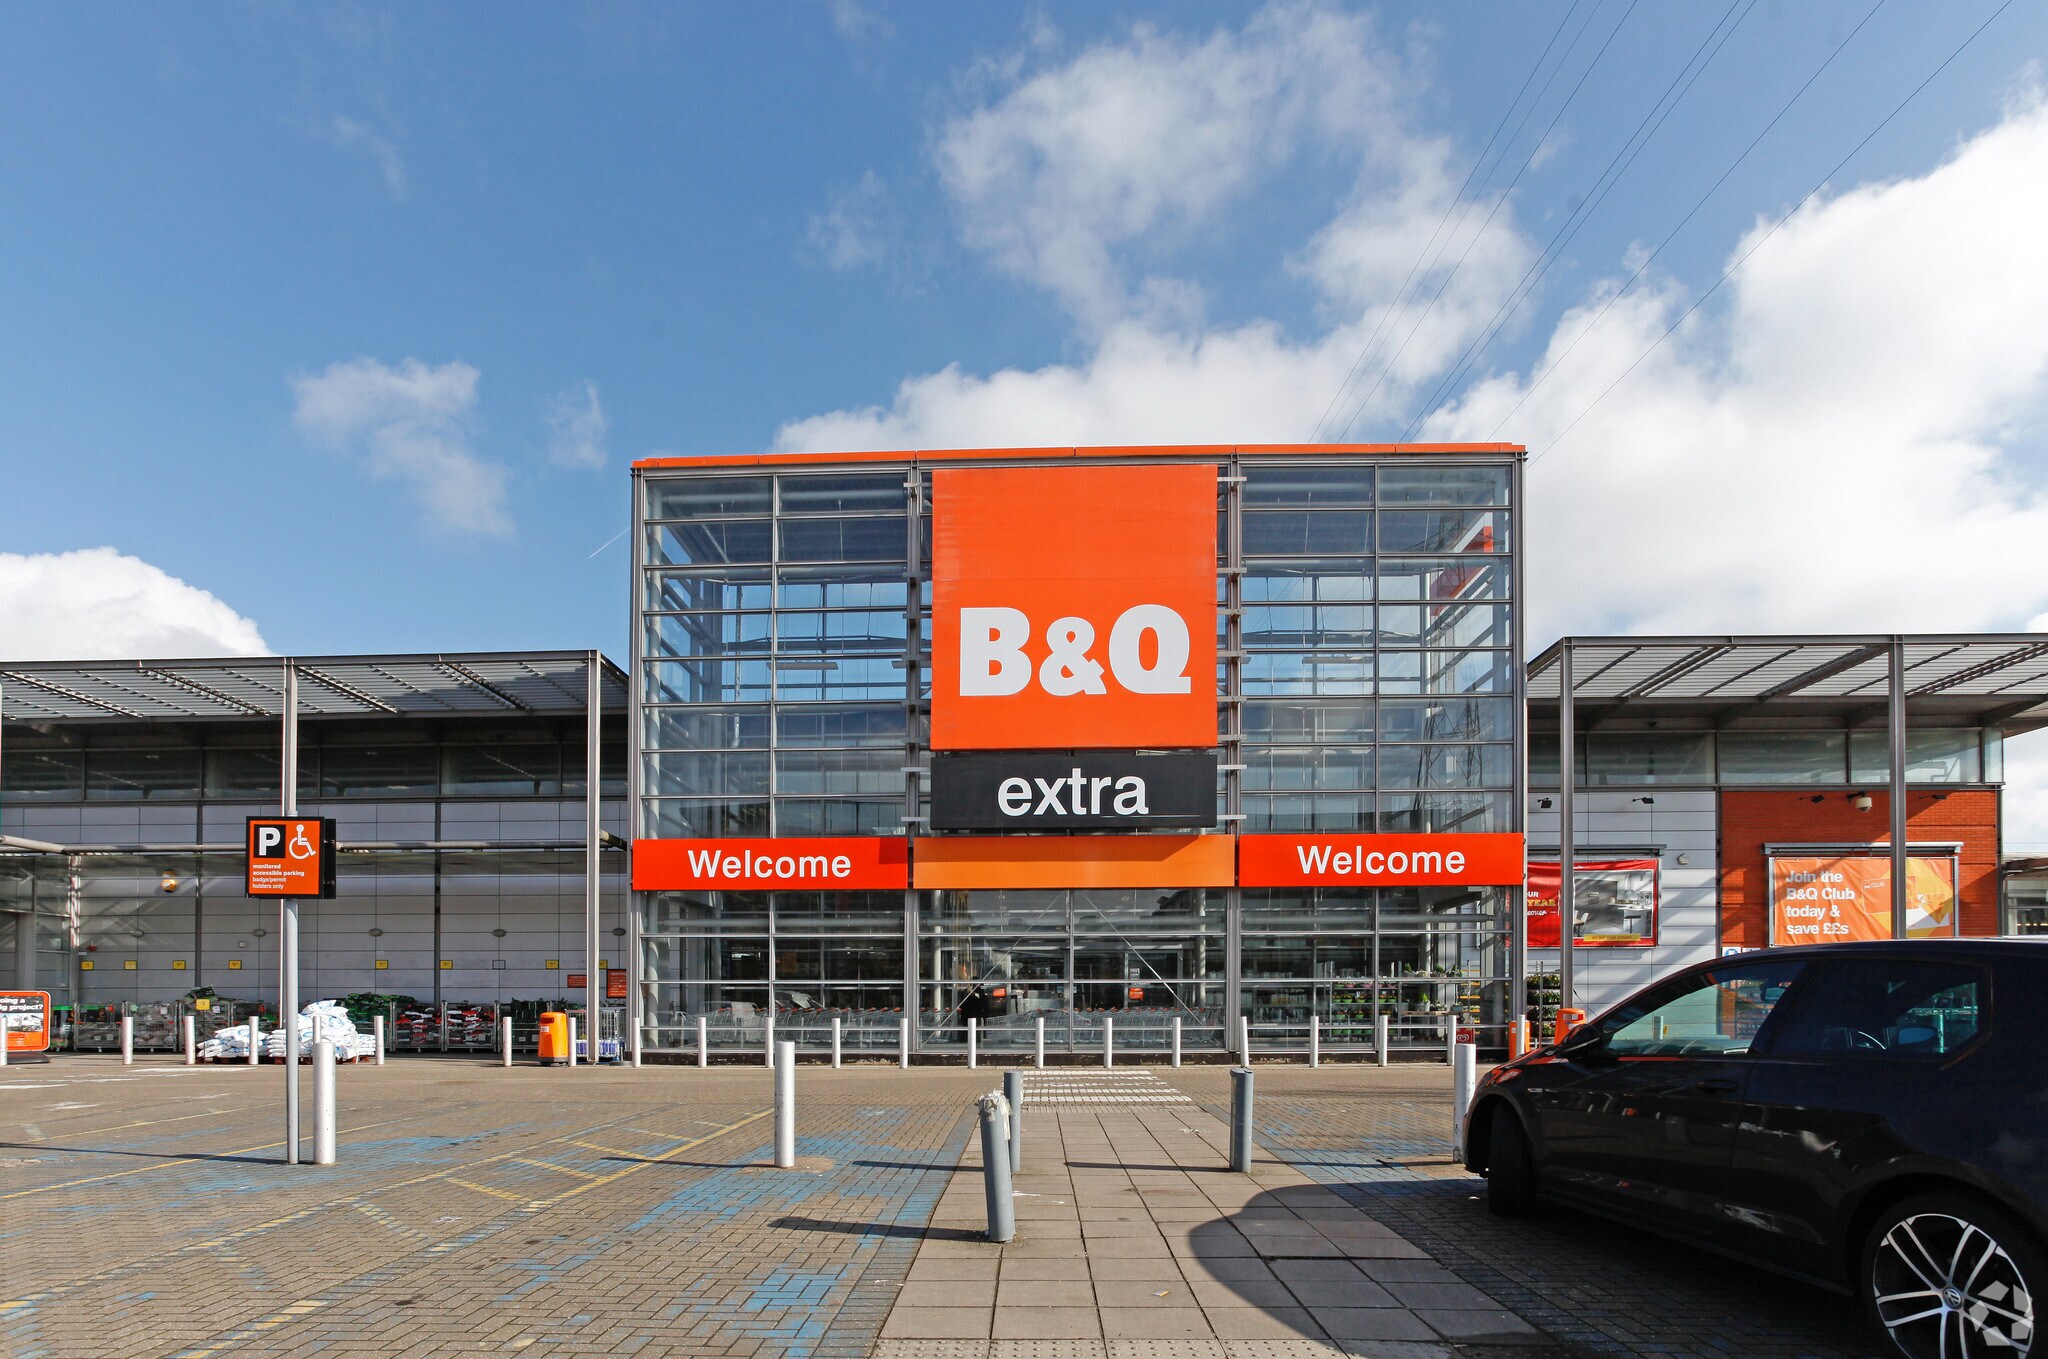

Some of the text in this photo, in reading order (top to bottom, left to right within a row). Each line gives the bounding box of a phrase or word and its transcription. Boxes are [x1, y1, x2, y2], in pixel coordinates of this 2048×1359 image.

[959, 604, 1192, 697] B&Q
[997, 767, 1150, 817] extra
[259, 827, 281, 856] P
[687, 849, 852, 879] Welcome
[1296, 845, 1466, 875] Welcome
[1786, 871, 1843, 883] Join the
[1786, 887, 1856, 901] B&Q Club
[1786, 905, 1841, 920] today &
[1786, 922, 1849, 935] save ££s
